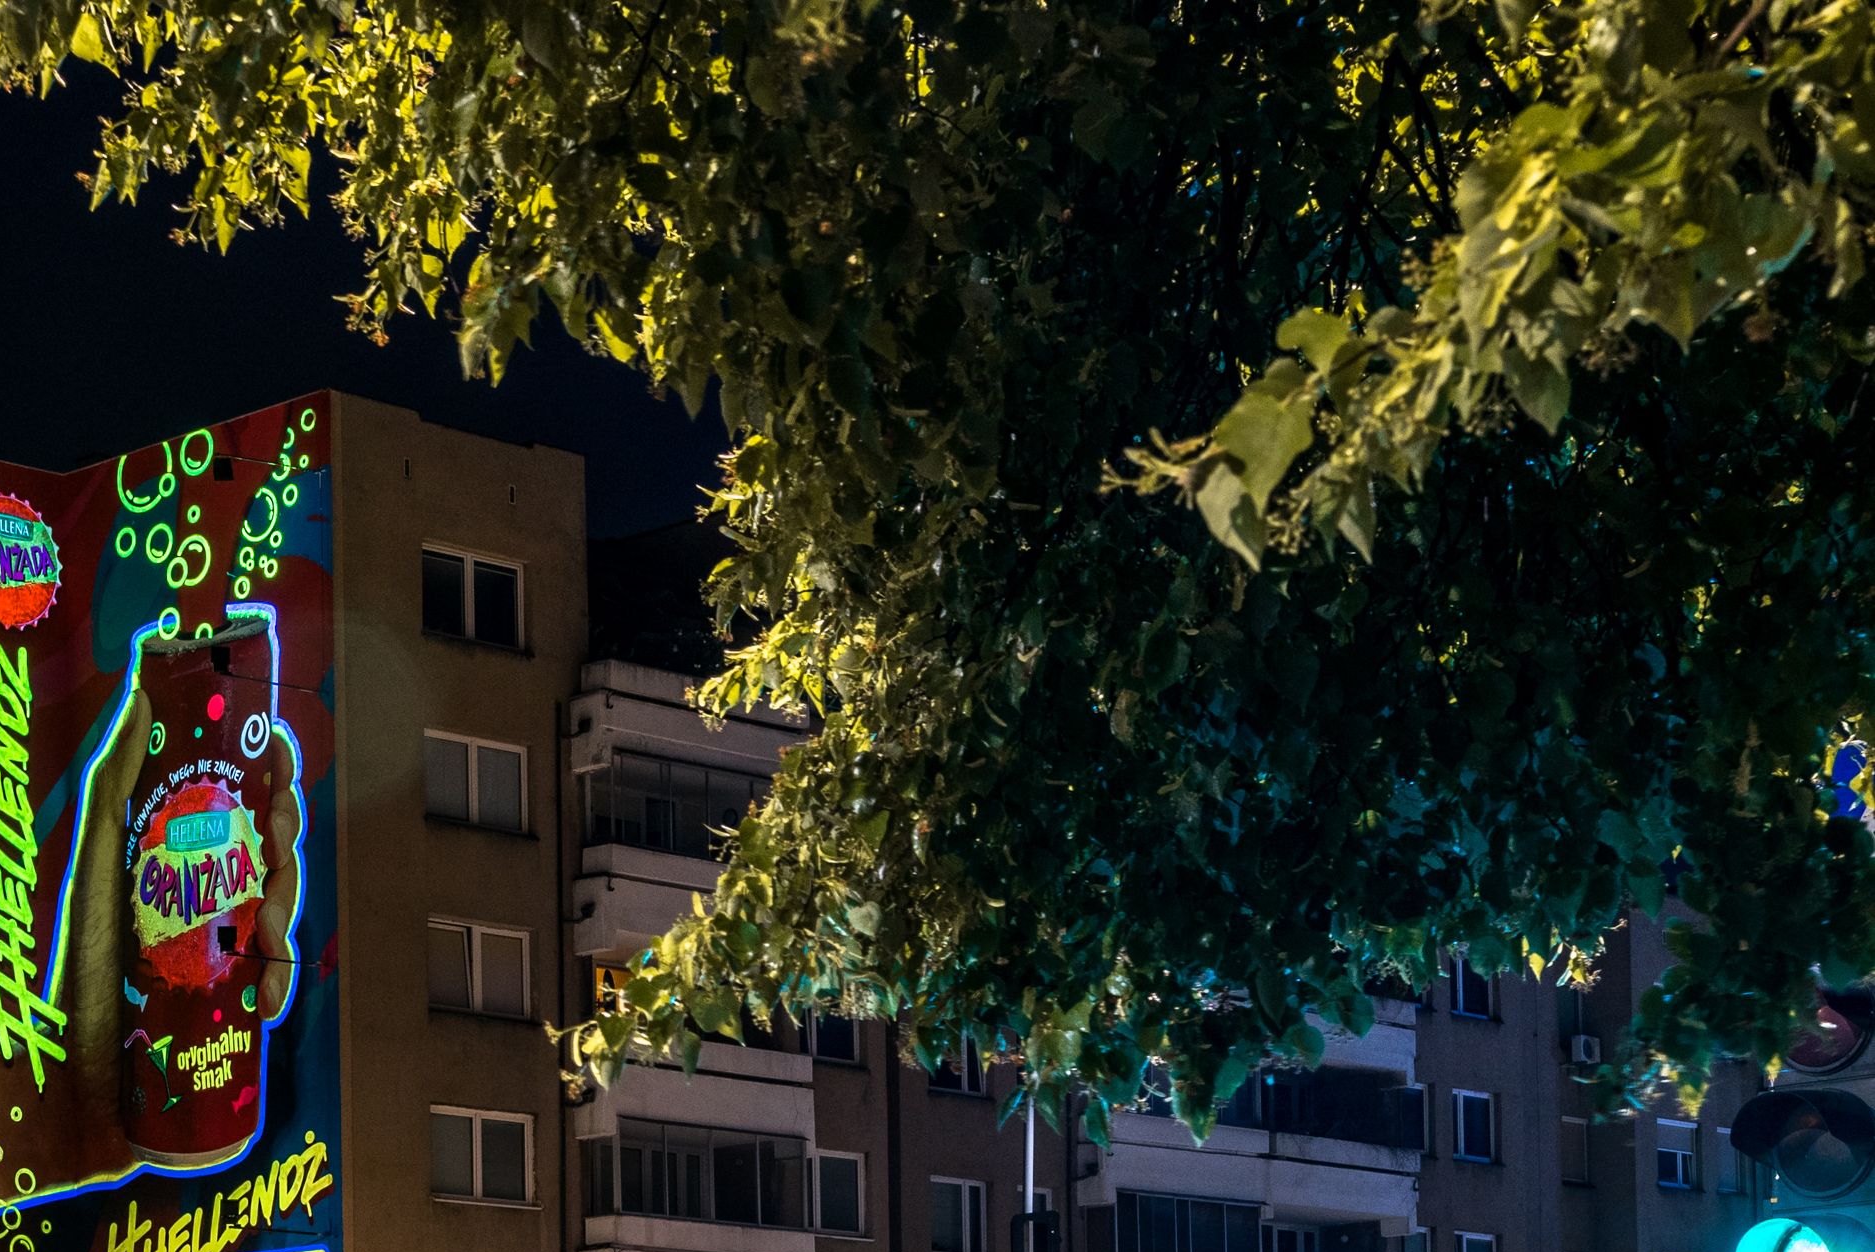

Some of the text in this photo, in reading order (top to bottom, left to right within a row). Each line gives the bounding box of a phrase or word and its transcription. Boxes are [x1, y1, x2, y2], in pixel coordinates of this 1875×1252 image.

[134, 782, 168, 832] CHWALICIE,
[169, 764, 195, 787] SWEGO
[198, 759, 212, 774] NIE
[214, 760, 244, 784] ZNACIE!
[170, 818, 224, 844] HELLENA
[139, 839, 258, 926] ORANŻADA
[177, 1025, 251, 1071] oryginalny
[193, 1058, 232, 1091] smak
